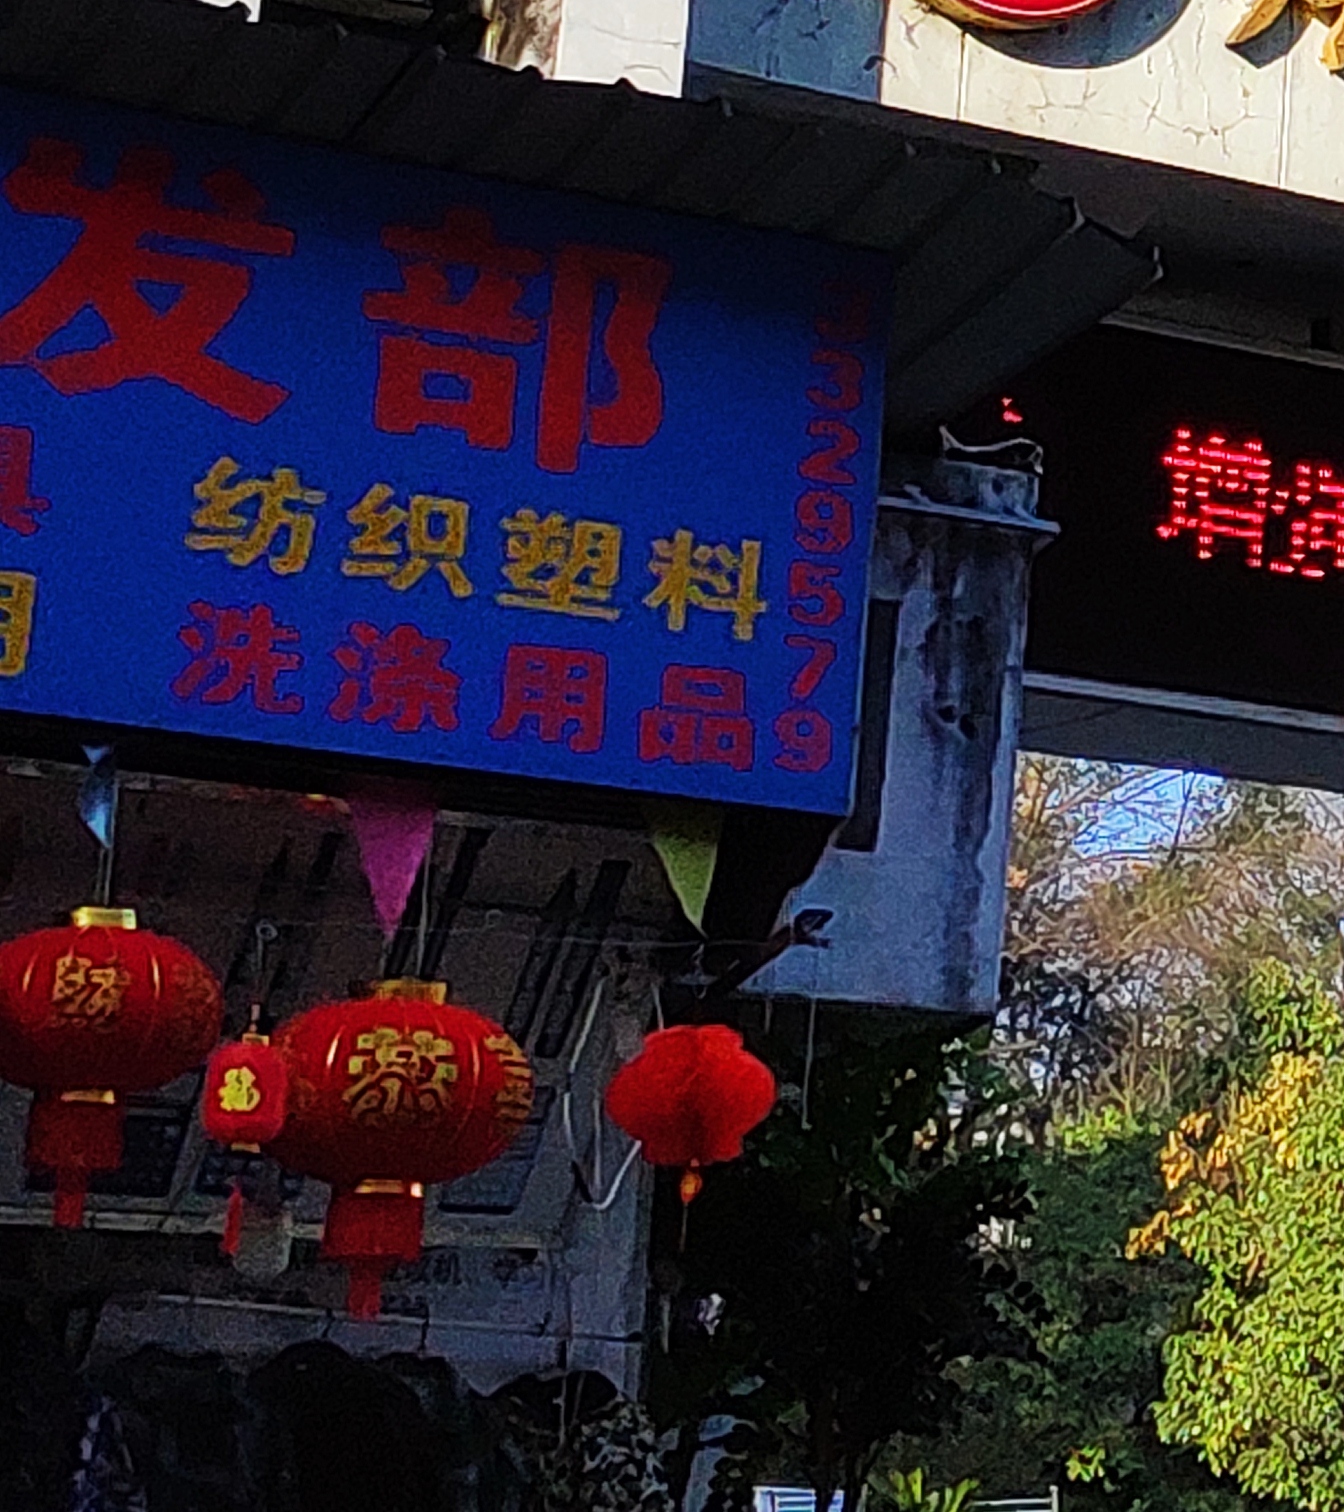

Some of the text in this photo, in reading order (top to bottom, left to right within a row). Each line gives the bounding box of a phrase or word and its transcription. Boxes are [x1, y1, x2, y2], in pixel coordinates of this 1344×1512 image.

[184, 455, 768, 643] 纺织塑料
[169, 600, 757, 774] 洗涤用品
